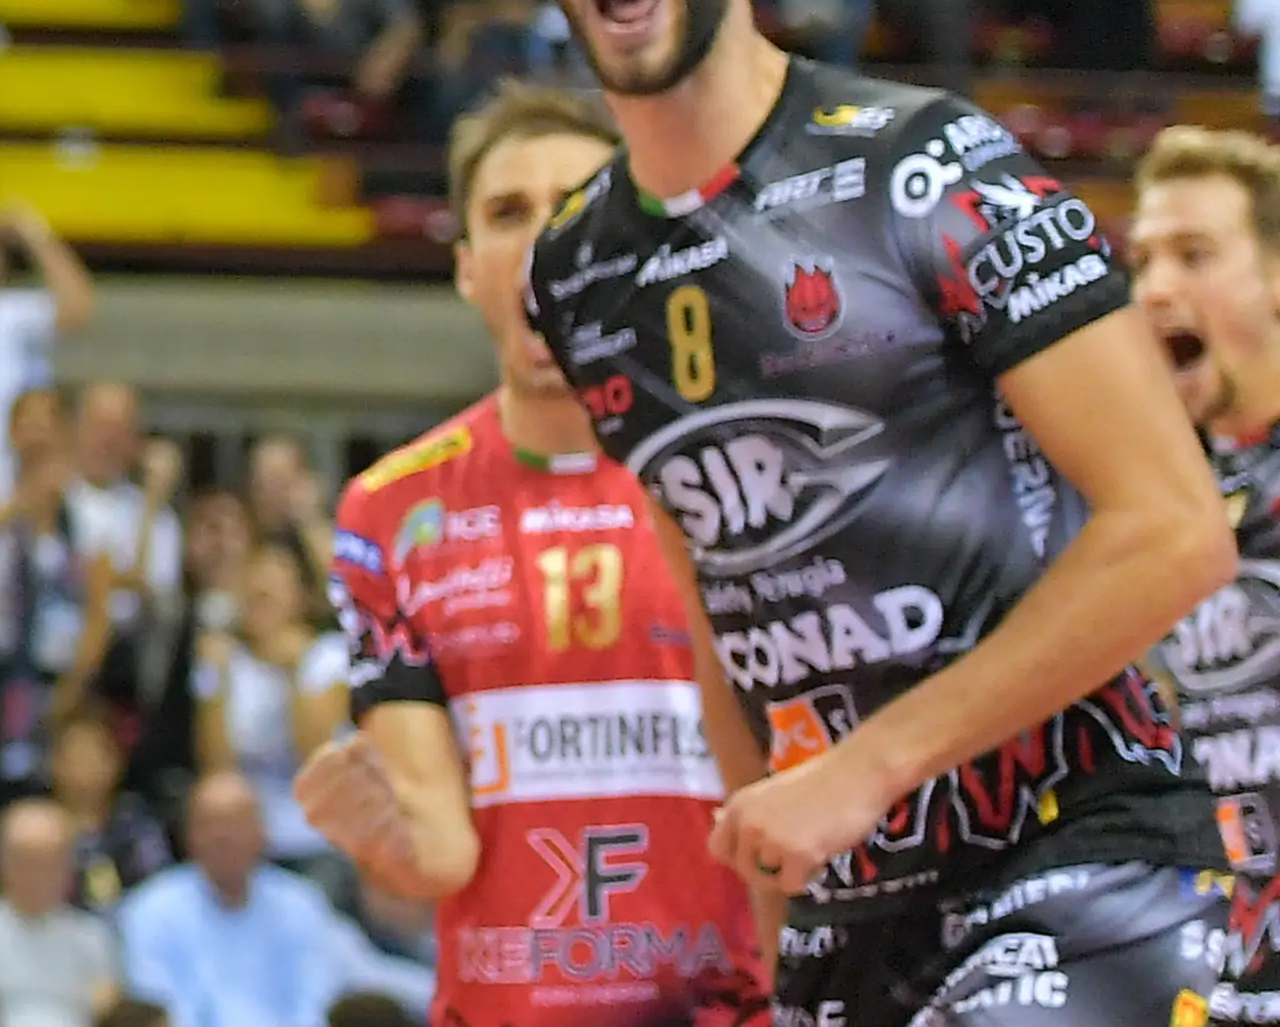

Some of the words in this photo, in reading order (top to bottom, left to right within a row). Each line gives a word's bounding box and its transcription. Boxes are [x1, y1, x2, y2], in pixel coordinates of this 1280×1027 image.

[666, 285, 716, 403] 8
[660, 434, 795, 550] SIR
[535, 542, 624, 653] 13
